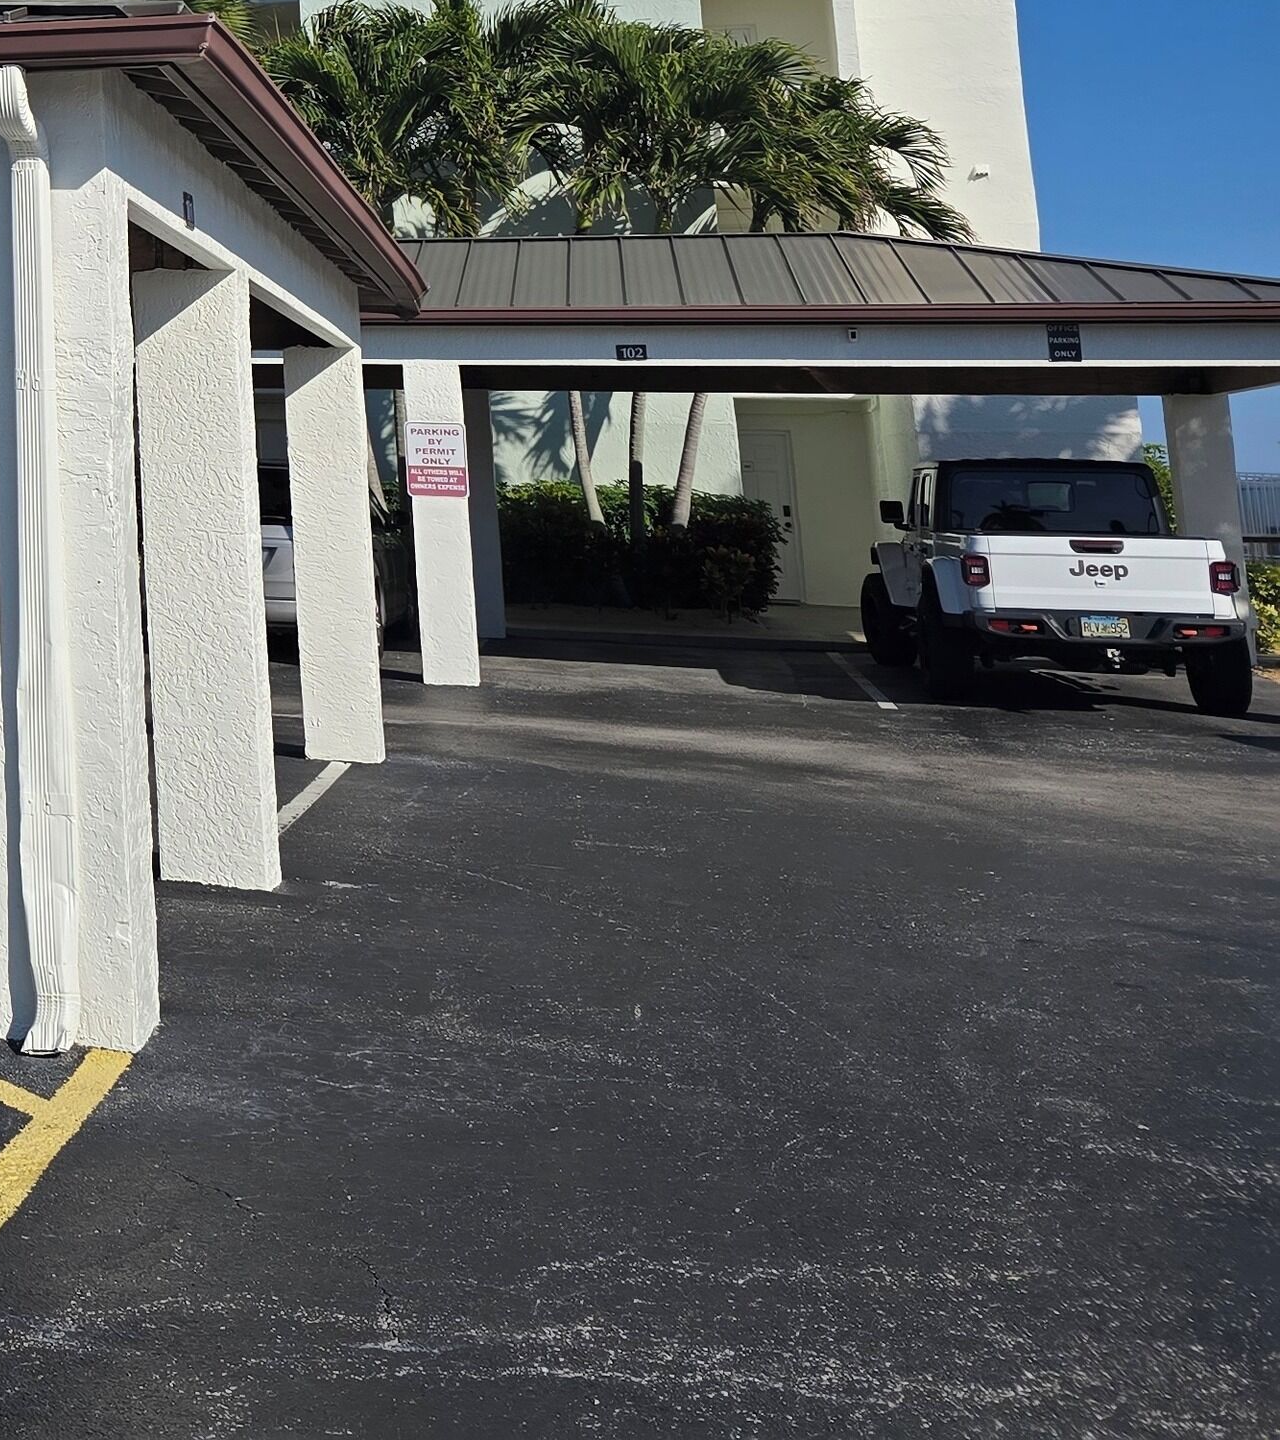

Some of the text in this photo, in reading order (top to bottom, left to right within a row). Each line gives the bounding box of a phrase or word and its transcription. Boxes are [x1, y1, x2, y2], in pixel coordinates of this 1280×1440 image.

[620, 347, 644, 359] 102
[410, 428, 460, 436] PARKING
[1069, 560, 1129, 581] Jeep
[1110, 622, 1128, 634] 952
